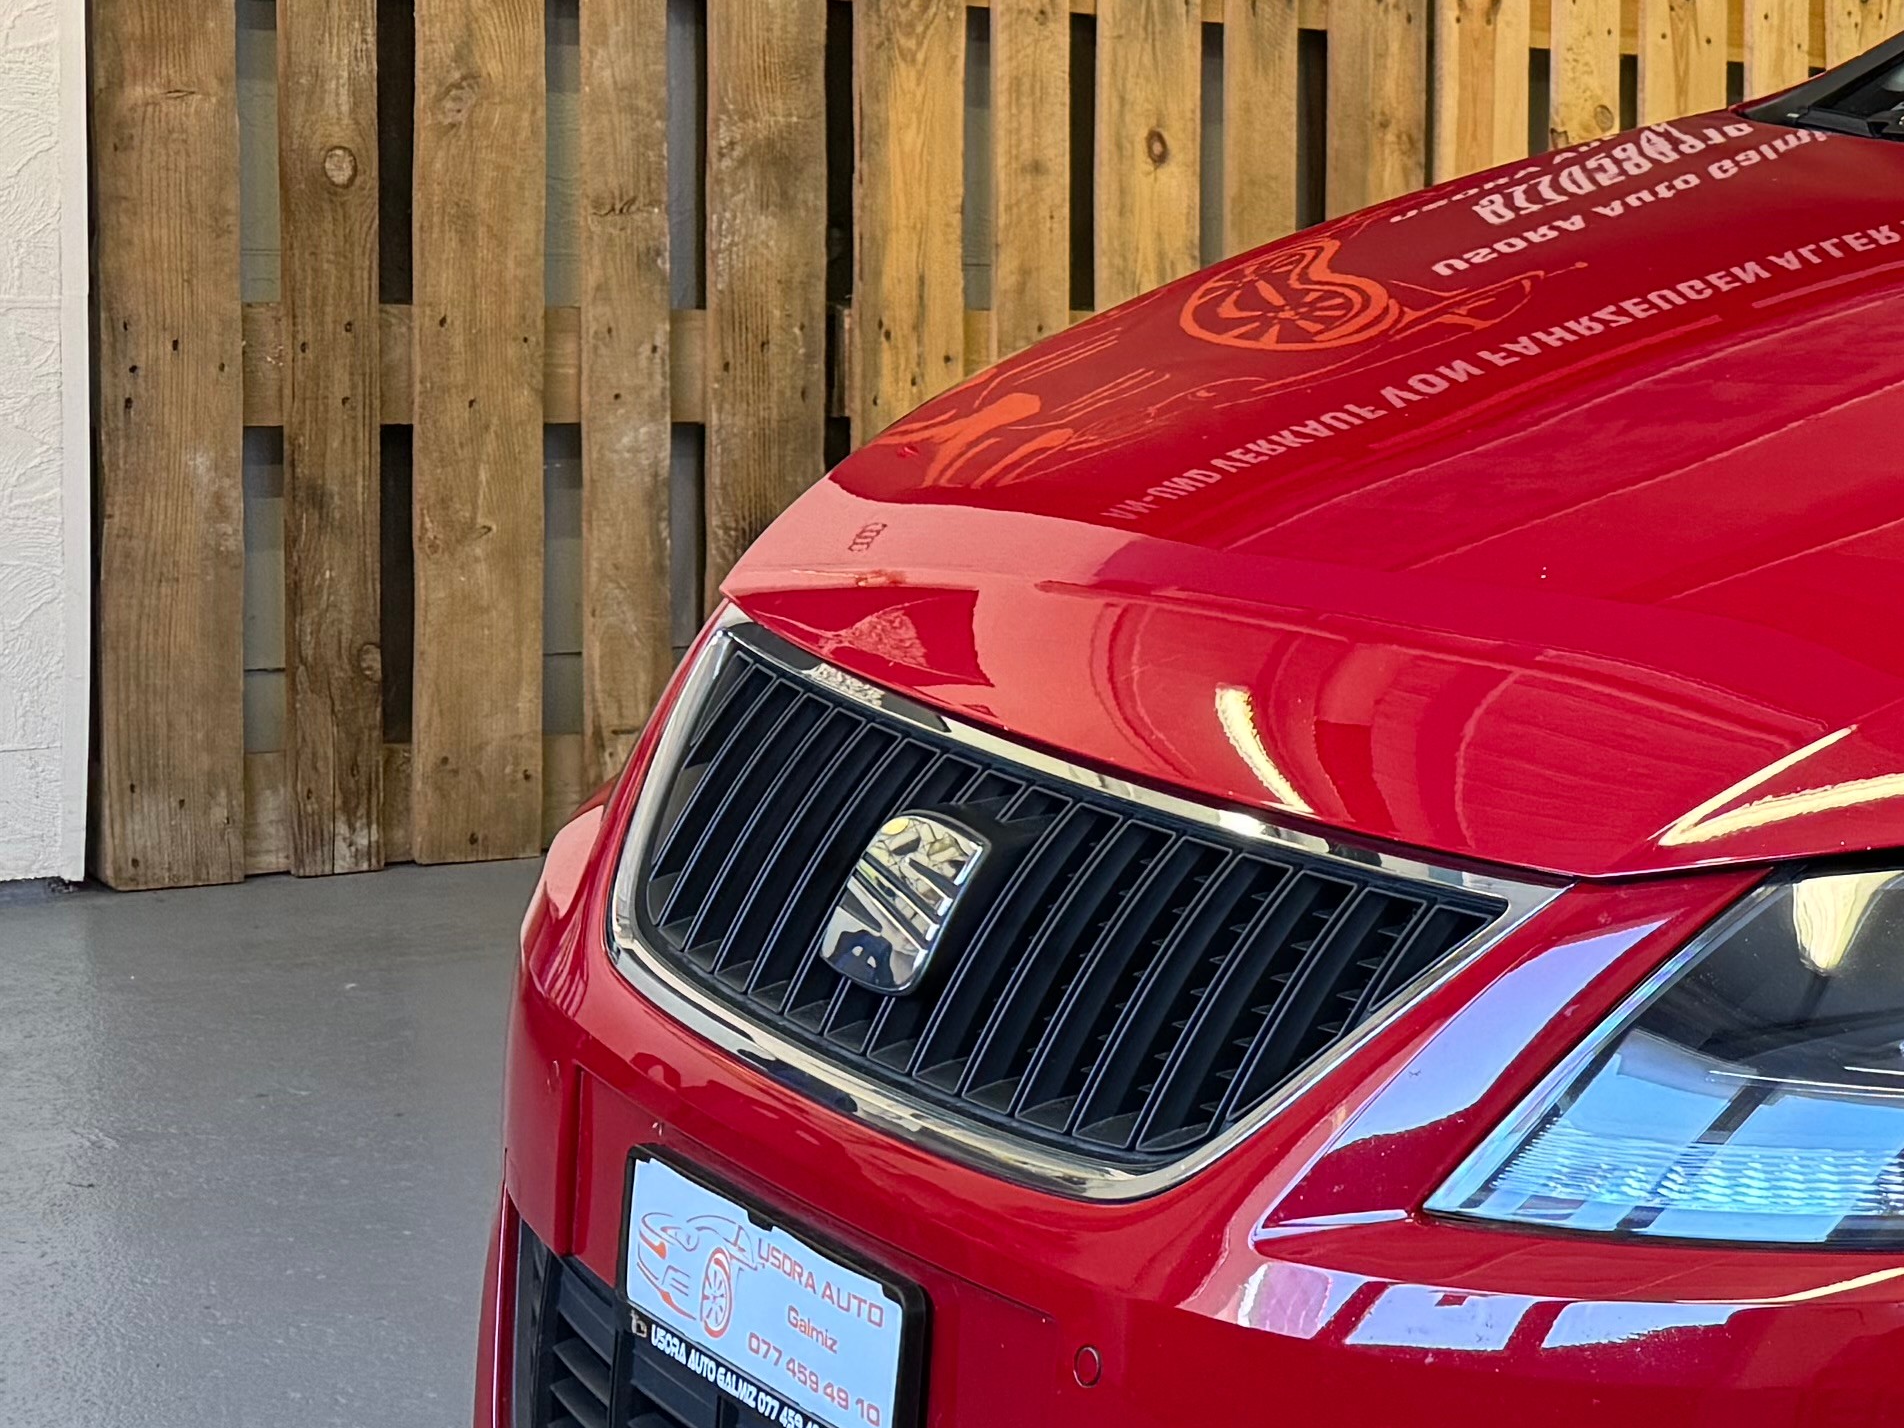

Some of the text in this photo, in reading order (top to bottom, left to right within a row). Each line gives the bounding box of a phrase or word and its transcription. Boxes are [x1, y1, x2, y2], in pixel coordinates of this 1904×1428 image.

[757, 1237, 885, 1328] USORA AUTO
[651, 1324, 687, 1365] USORA
[687, 1349, 716, 1383] AUTO
[716, 1366, 756, 1408] GALMIZ
[757, 1394, 780, 1421] 077
[786, 1305, 838, 1354] Galmiz
[748, 1332, 881, 1427] 077 459 49 10
